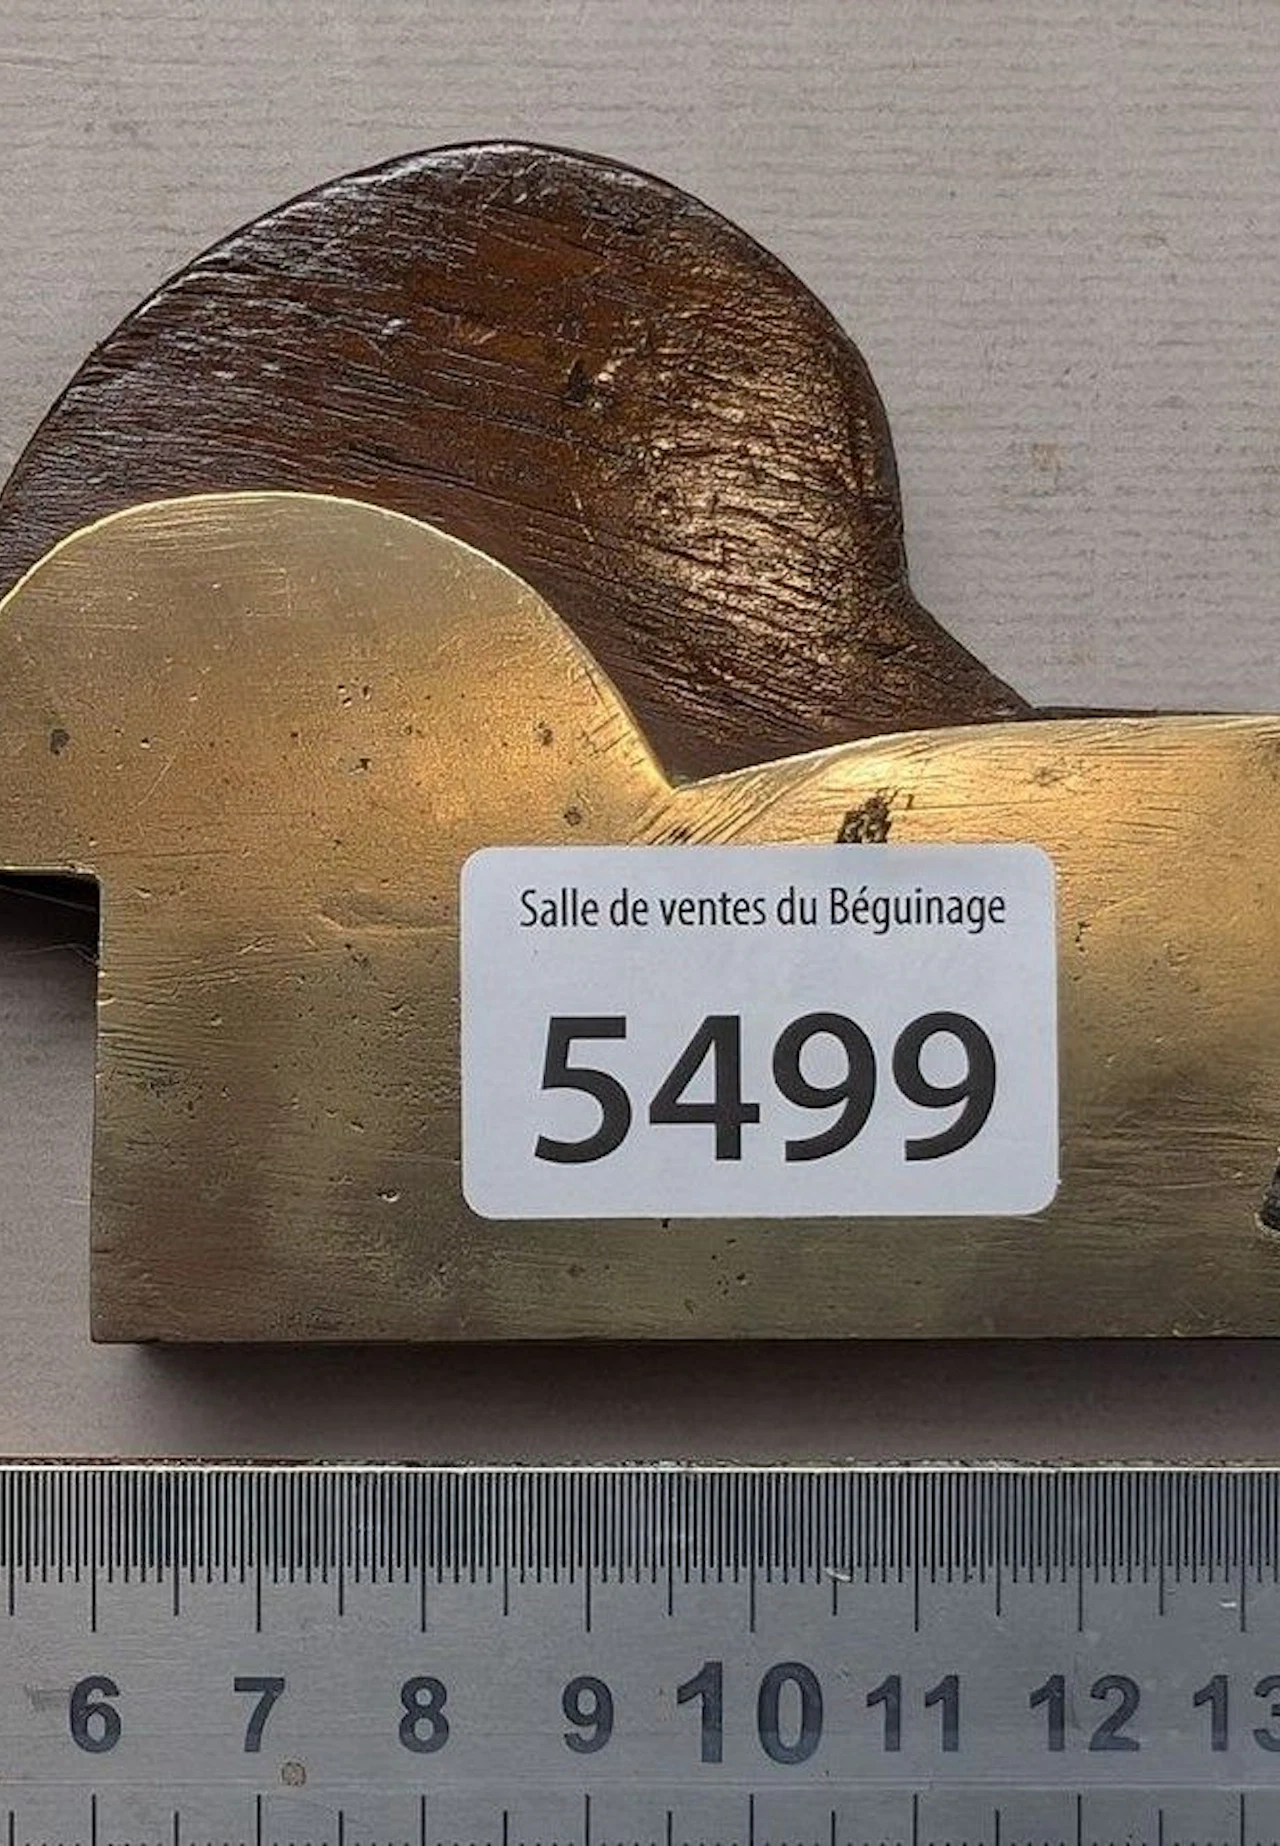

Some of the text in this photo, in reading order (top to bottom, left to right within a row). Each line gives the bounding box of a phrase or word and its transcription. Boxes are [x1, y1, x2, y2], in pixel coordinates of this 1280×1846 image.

[520, 887, 1006, 934] Salle de ventes du Béguinage
[534, 1011, 997, 1163] 5499
[68, 1676, 121, 1753] 6
[233, 1677, 286, 1752] 7
[398, 1676, 450, 1753] 8
[561, 1676, 614, 1753] 9
[676, 1661, 823, 1765] 10
[866, 1675, 962, 1752] 11
[1029, 1675, 1141, 1752] 12
